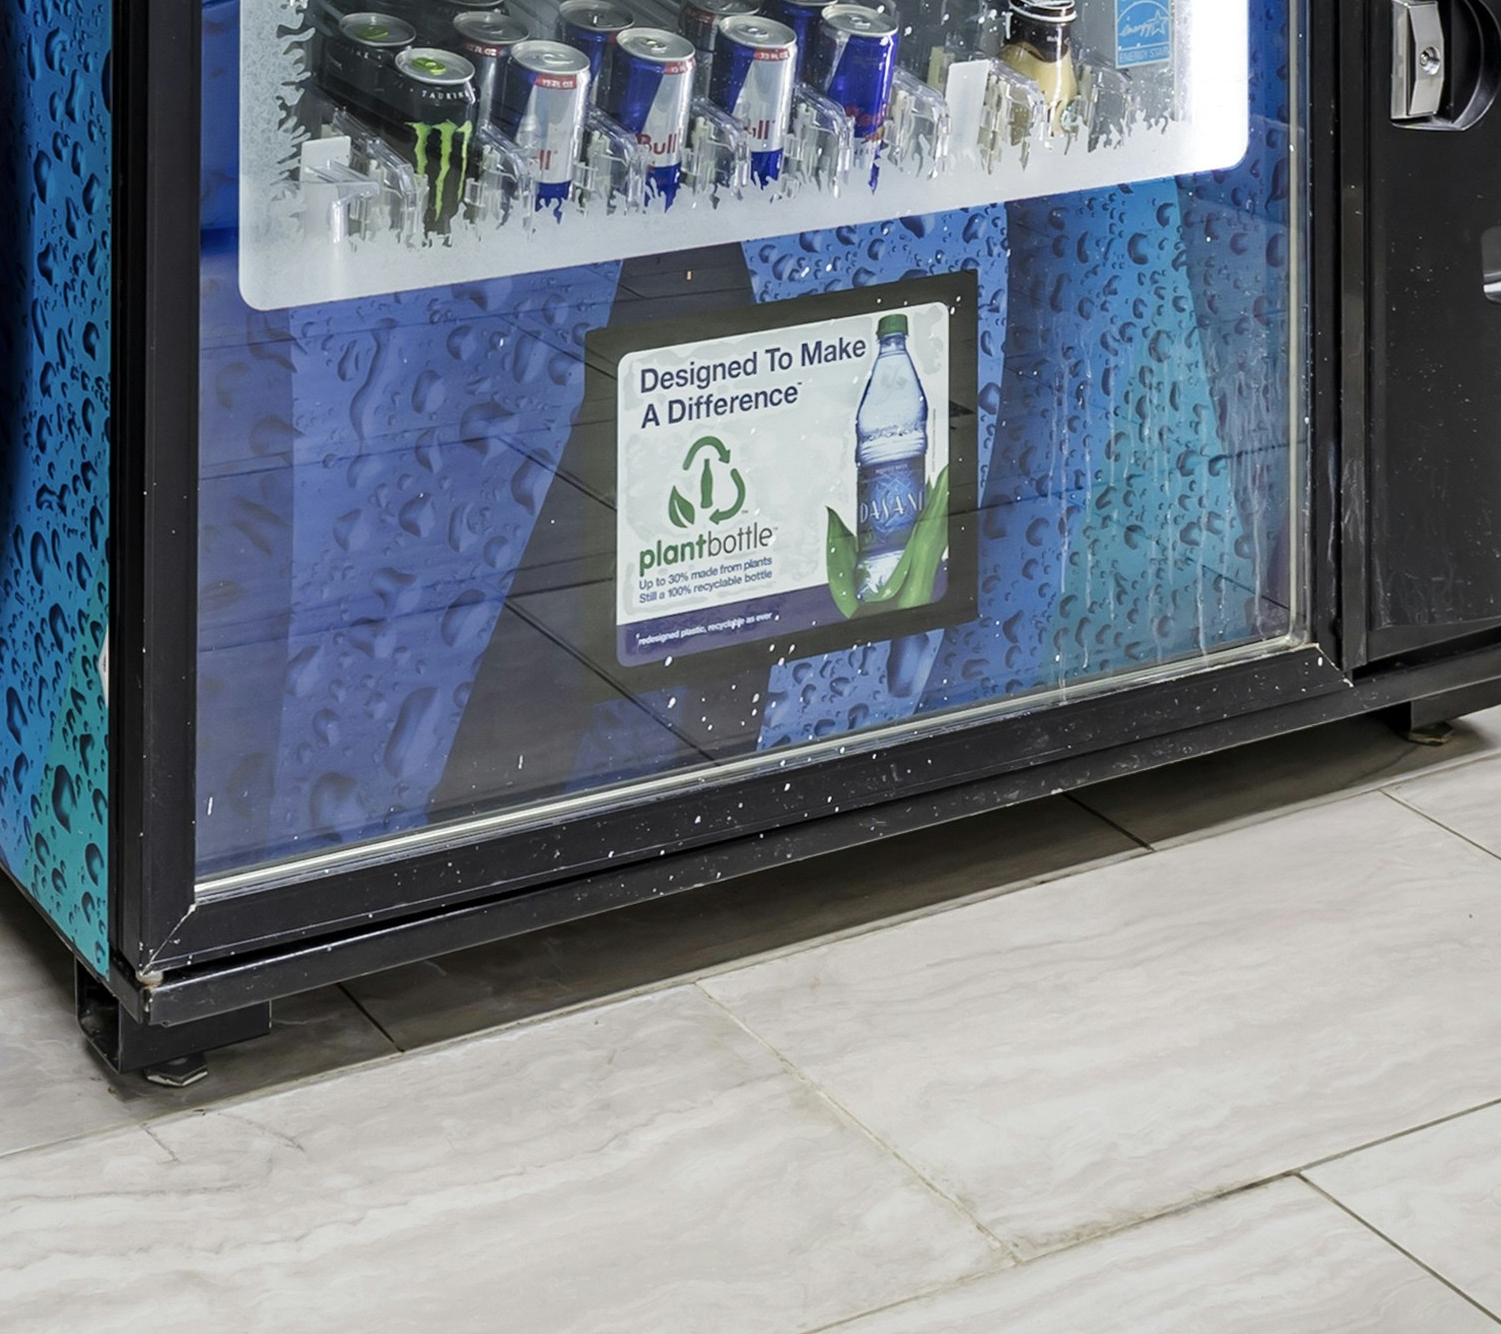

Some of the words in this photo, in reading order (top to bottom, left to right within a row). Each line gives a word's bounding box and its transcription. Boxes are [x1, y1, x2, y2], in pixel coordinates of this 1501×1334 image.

[640, 350, 758, 393] Designed
[765, 348, 793, 371] To
[801, 335, 867, 367] Make
[641, 403, 660, 429] A
[668, 384, 799, 425] Difference
[860, 489, 926, 524] DASANI
[639, 521, 774, 577] plantbottle
[639, 578, 654, 592] Up
[655, 576, 666, 587] to
[668, 572, 689, 586] 30%
[691, 566, 718, 580] made
[719, 563, 742, 575] from
[743, 556, 773, 575] plants
[639, 590, 657, 604] Still
[659, 591, 666, 599] a
[667, 583, 692, 598] 100%
[693, 575, 743, 595] recyclable
[744, 569, 773, 584] bottle
